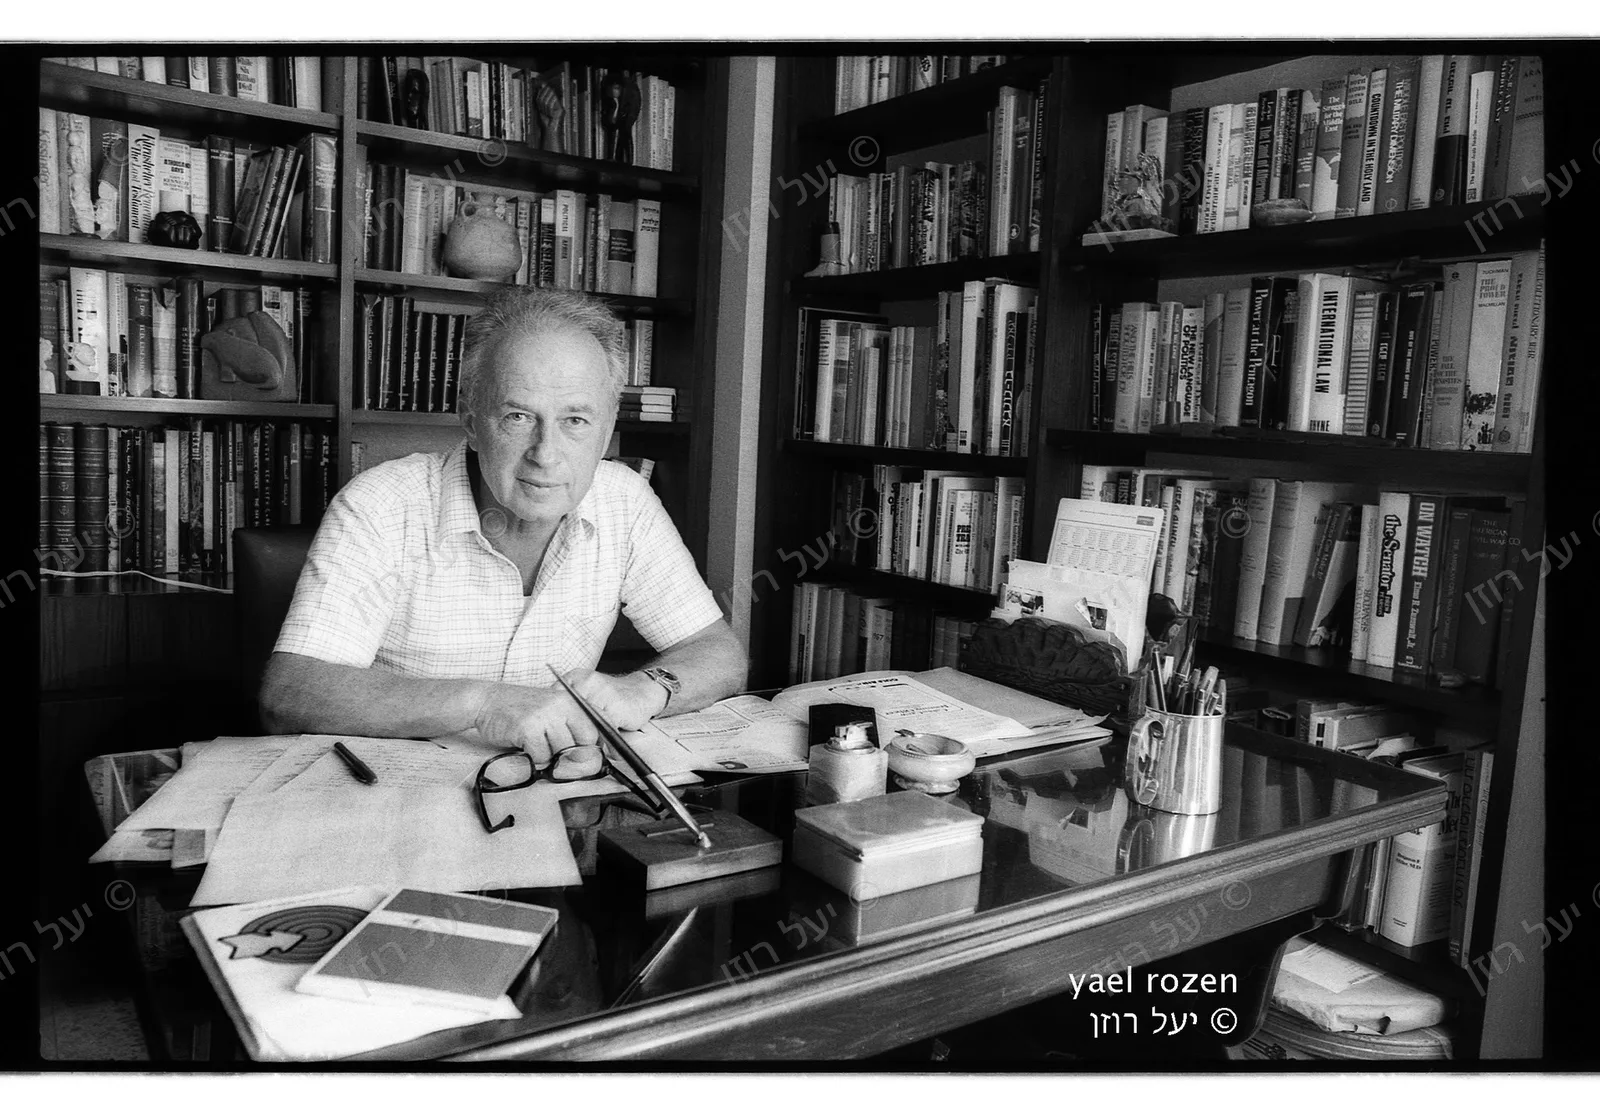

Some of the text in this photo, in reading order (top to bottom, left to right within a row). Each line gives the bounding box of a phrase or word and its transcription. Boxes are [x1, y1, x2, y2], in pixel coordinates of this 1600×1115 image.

[1386, 80, 1404, 184] THE MILITARY DIMENSION
[1444, 98, 1453, 114] עד
[40, 129, 51, 184] Kissinger
[134, 133, 156, 187] Khrushchev
[1361, 93, 1382, 202] COUNTDOWN IN THE HOLY LAND
[131, 144, 142, 229] The Last Testament
[1479, 291, 1506, 299] TOWER
[1529, 265, 1545, 339] REVOLUTIONARY
[1179, 324, 1191, 380] OF POLITICS
[1183, 325, 1198, 417] THE NEW LANGUAGE
[1244, 288, 1269, 406] Power at the Pentagon
[1314, 291, 1339, 394] INTERNATIONAL LAW
[1002, 370, 1014, 428] בר-כוכבא
[1380, 515, 1401, 590] the Senator
[1411, 502, 1436, 578] ON WATCH
[1360, 589, 1371, 632] SENATOR
[1412, 581, 1423, 600] Elmo
